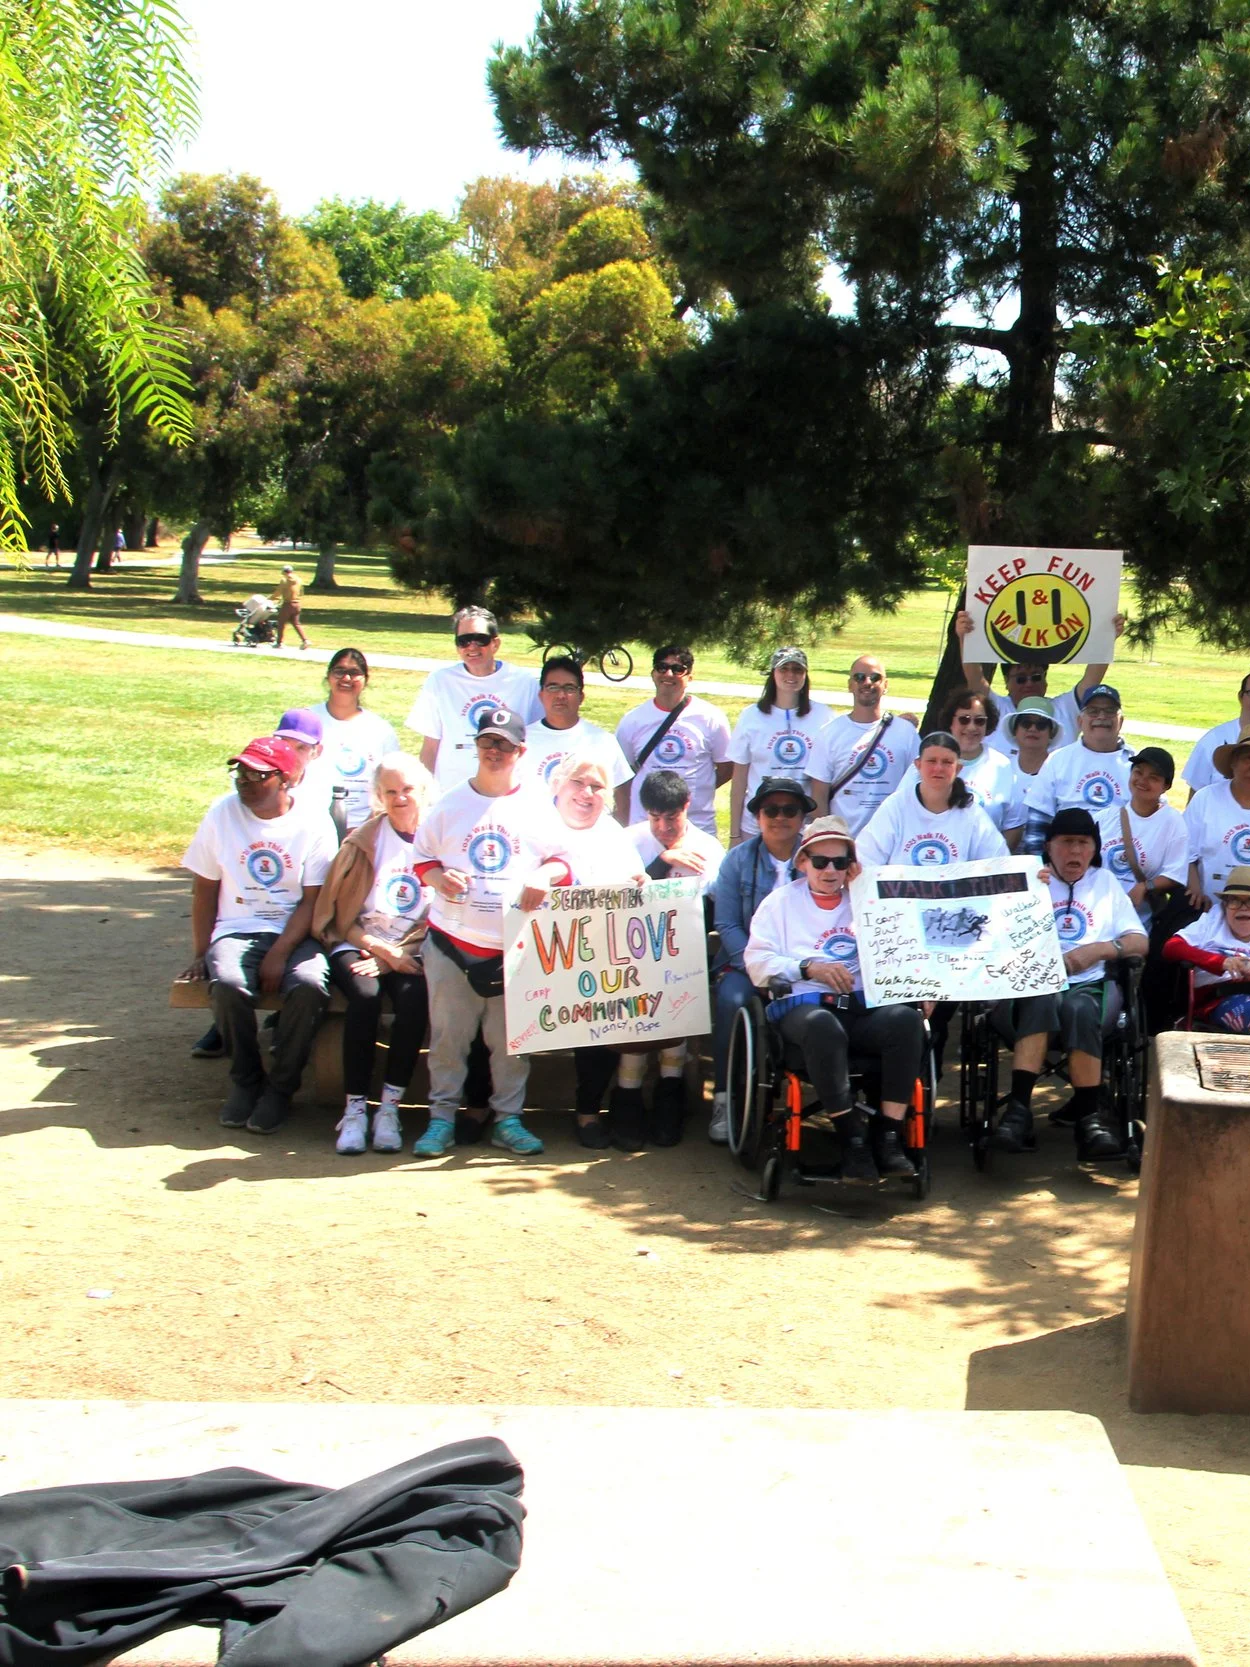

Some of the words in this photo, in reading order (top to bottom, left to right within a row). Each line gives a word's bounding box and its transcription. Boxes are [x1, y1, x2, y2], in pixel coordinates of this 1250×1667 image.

[974, 557, 1026, 605] KEEP
[1047, 556, 1095, 592] FUN
[1032, 589, 1048, 605] &
[994, 610, 1049, 646] WALK
[1055, 613, 1084, 640] ON
[935, 833, 950, 842] This
[881, 881, 944, 898] WALK
[863, 912, 873, 927] I
[531, 915, 595, 975] WE
[606, 910, 679, 965] LOVE
[905, 953, 930, 961] 2025
[578, 966, 640, 997] OUR
[539, 991, 663, 1031] COMMUNITY
